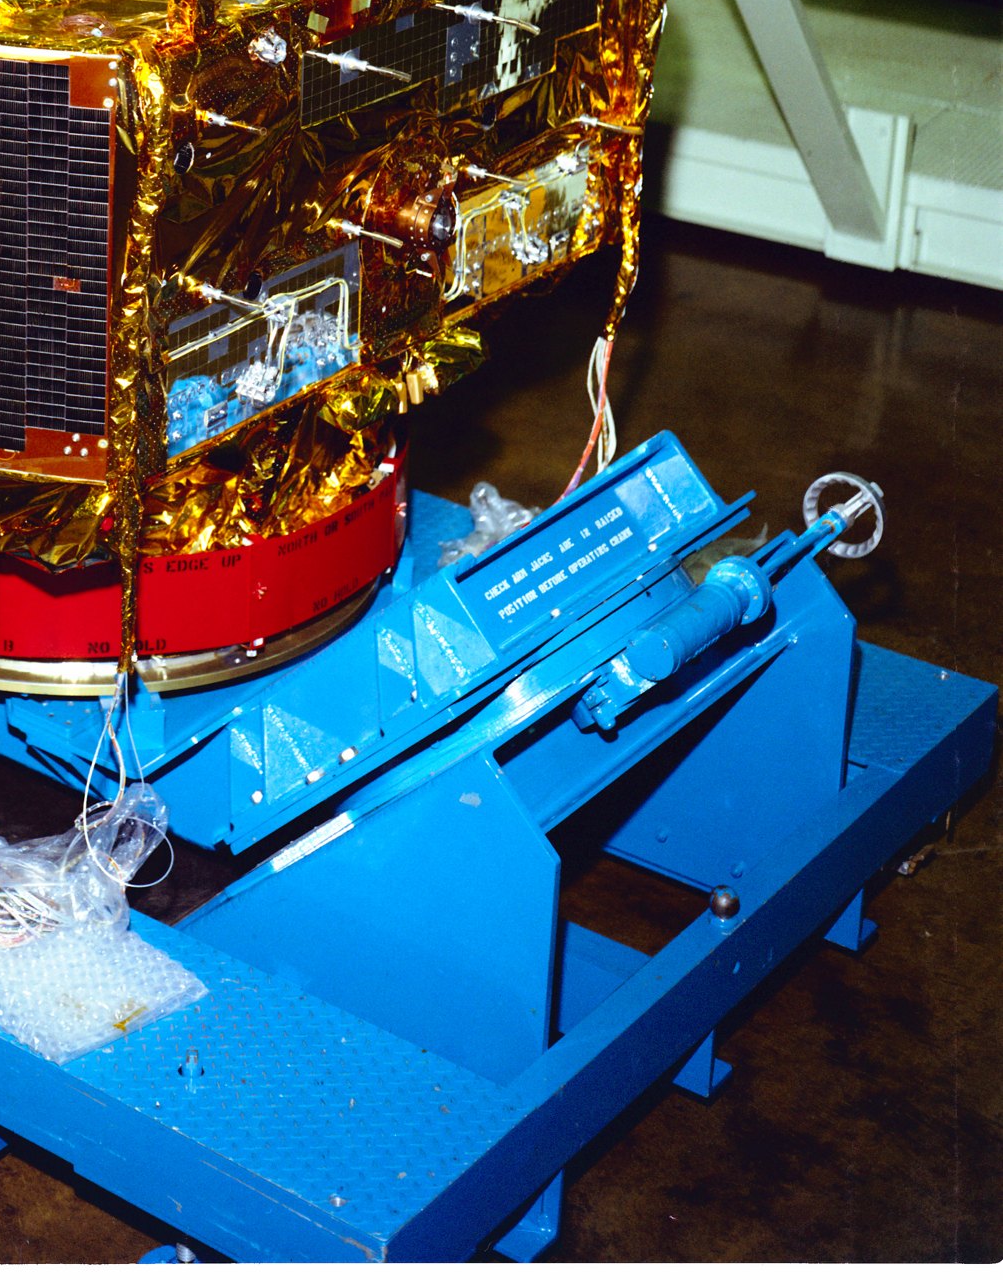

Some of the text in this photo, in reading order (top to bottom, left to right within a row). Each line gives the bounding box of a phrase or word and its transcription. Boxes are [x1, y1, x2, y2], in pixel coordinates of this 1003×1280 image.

[278, 531, 318, 557] NORTH
[324, 520, 338, 537] OR
[484, 579, 511, 600] CHECK
[530, 552, 553, 572] JACKS
[559, 537, 575, 553] ARE
[595, 506, 623, 530] RAISED
[166, 557, 209, 573] EDGE
[221, 554, 241, 568] UP
[498, 526, 634, 619] POSITION BEFORE OPERATING CRANK
[87, 639, 167, 654] NO OLD
